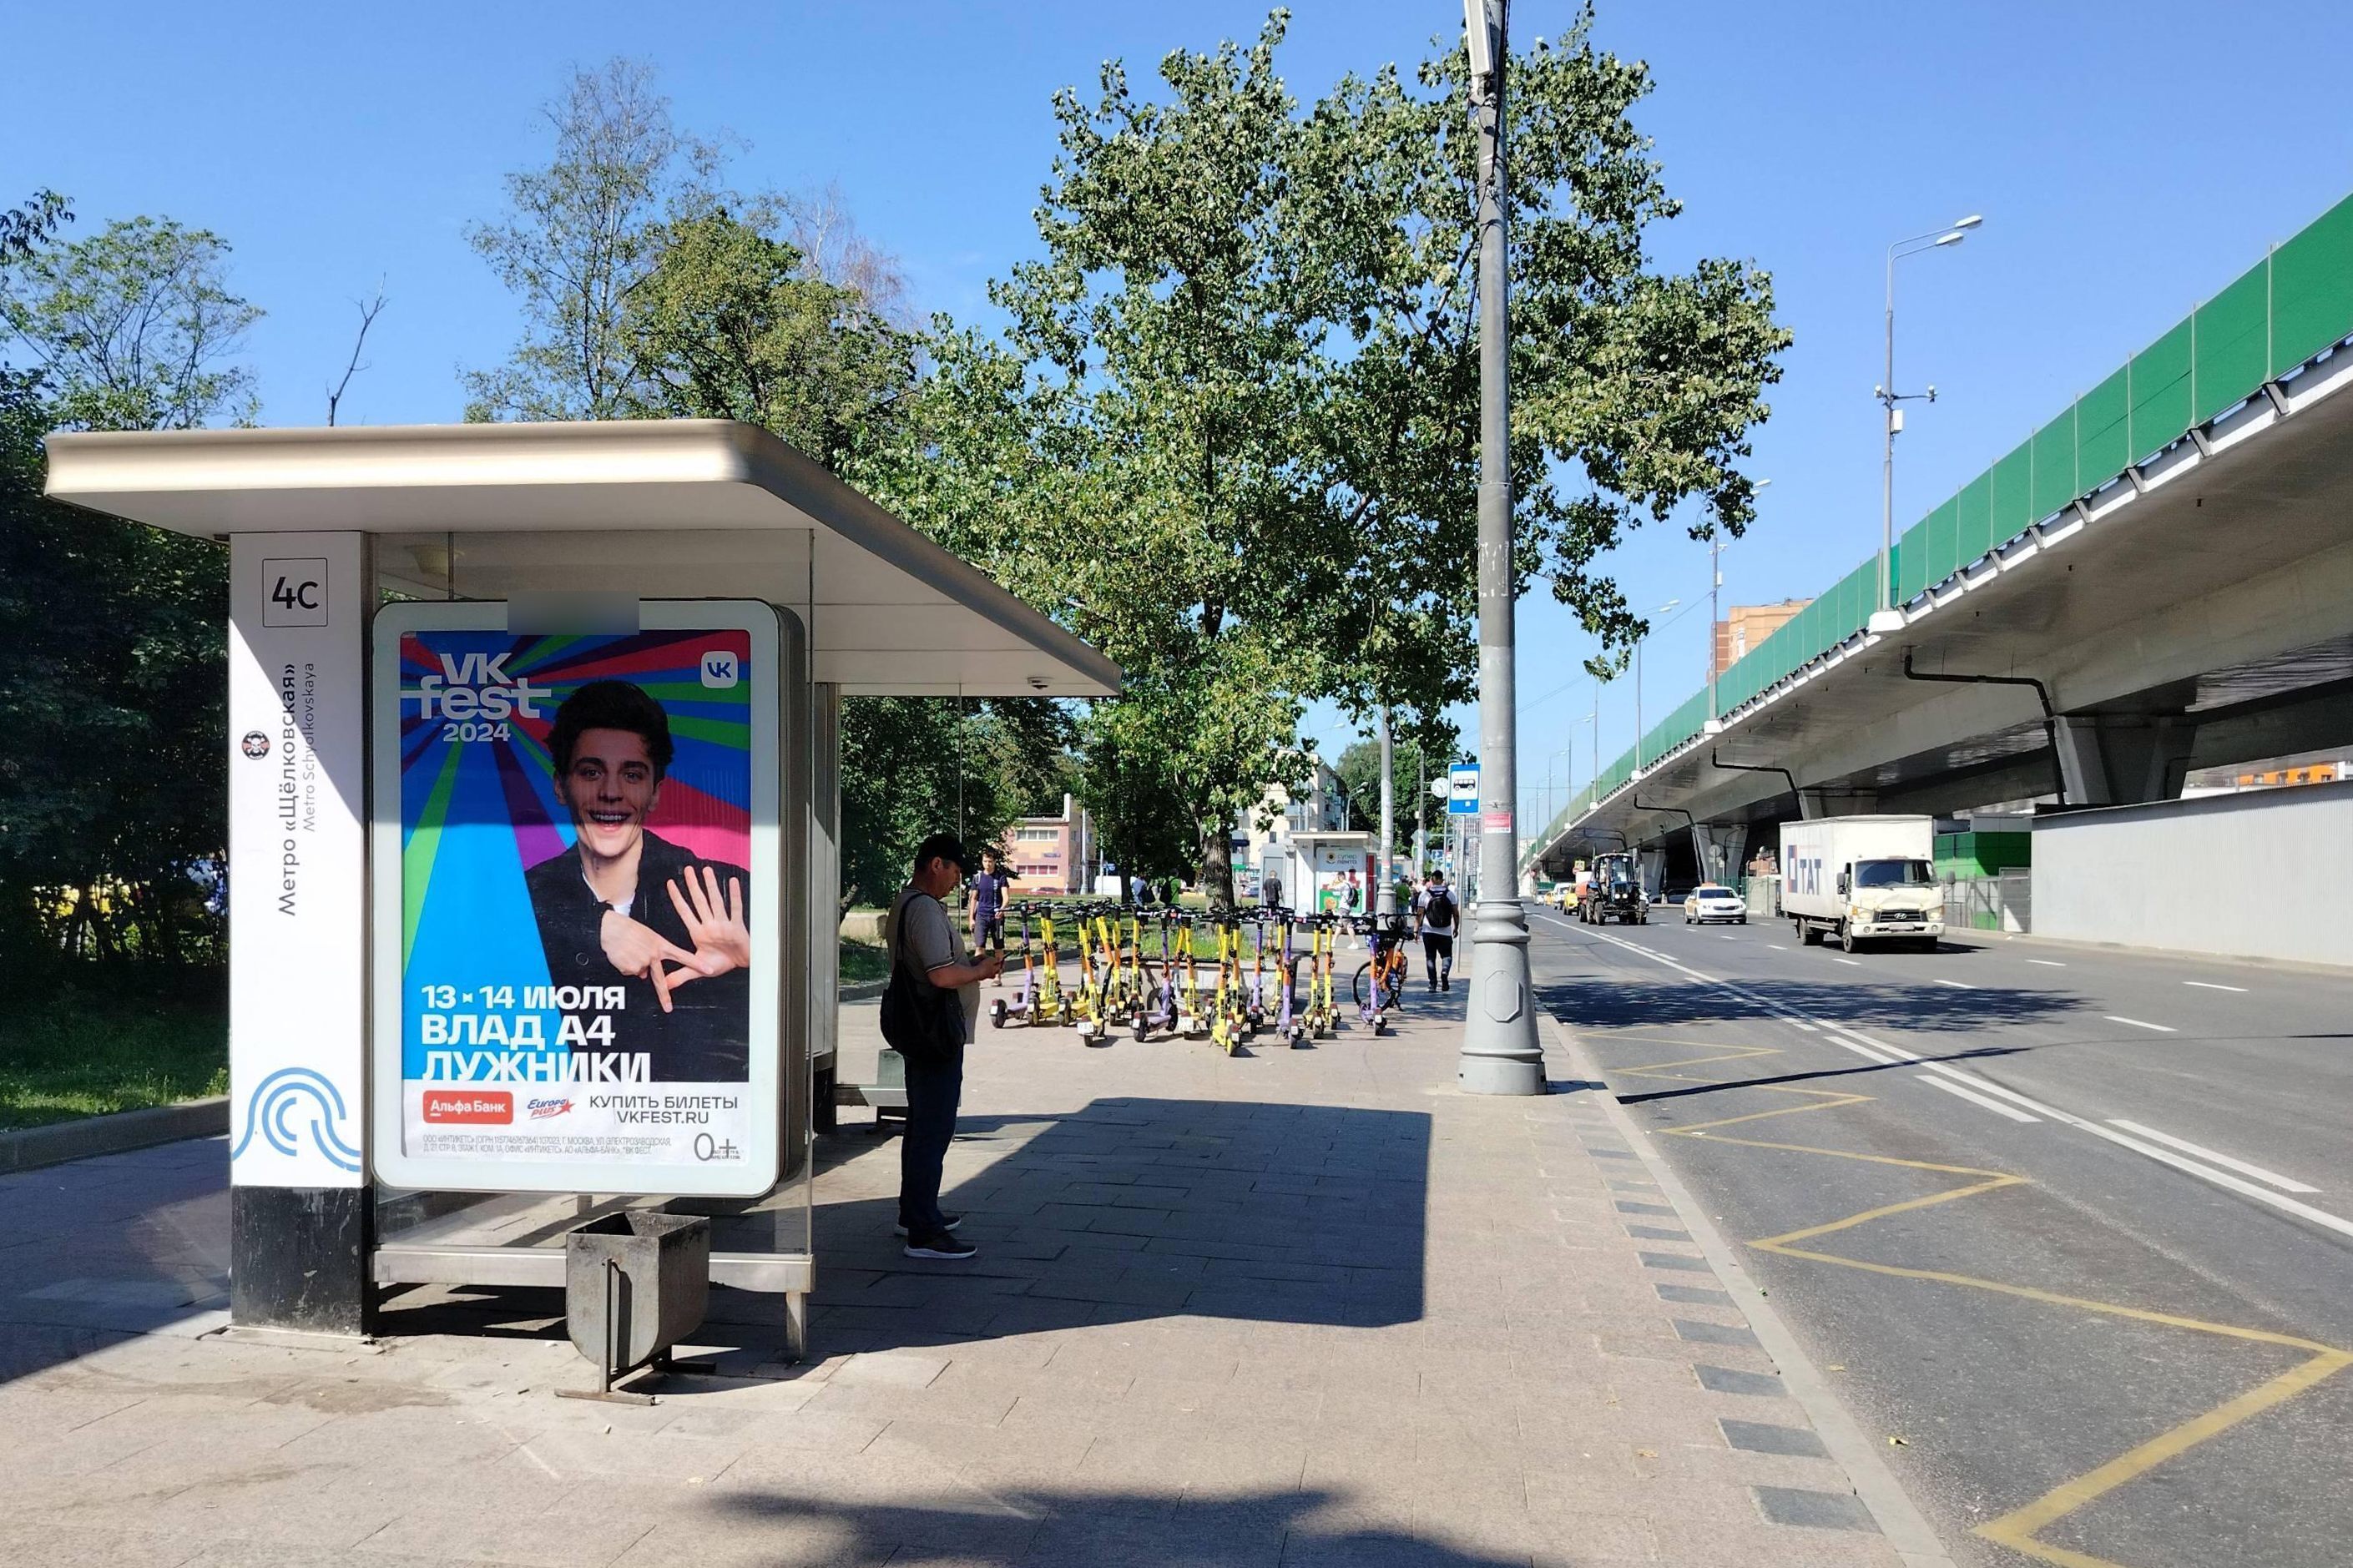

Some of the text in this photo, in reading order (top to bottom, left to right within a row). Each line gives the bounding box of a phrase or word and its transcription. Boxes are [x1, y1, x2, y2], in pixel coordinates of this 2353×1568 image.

[439, 653, 513, 685] VK
[707, 662, 732, 678] VK
[401, 674, 552, 720] fest
[301, 663, 317, 832] Metro Schyolkovskaya
[443, 723, 511, 743] 2024
[278, 663, 300, 916] Метро «Щёлковская»
[421, 985, 625, 1011] 13 14 ИЮЛЯ
[421, 1014, 547, 1051] ВЛАД
[422, 1051, 651, 1083] ЛУЖНИКИ
[430, 1099, 507, 1115] Альфа Банк
[589, 1096, 739, 1110] КУПИТЬ БИЛЕТЫ
[617, 1111, 710, 1124] VKFEST.RU
[694, 1132, 737, 1162] 0+
